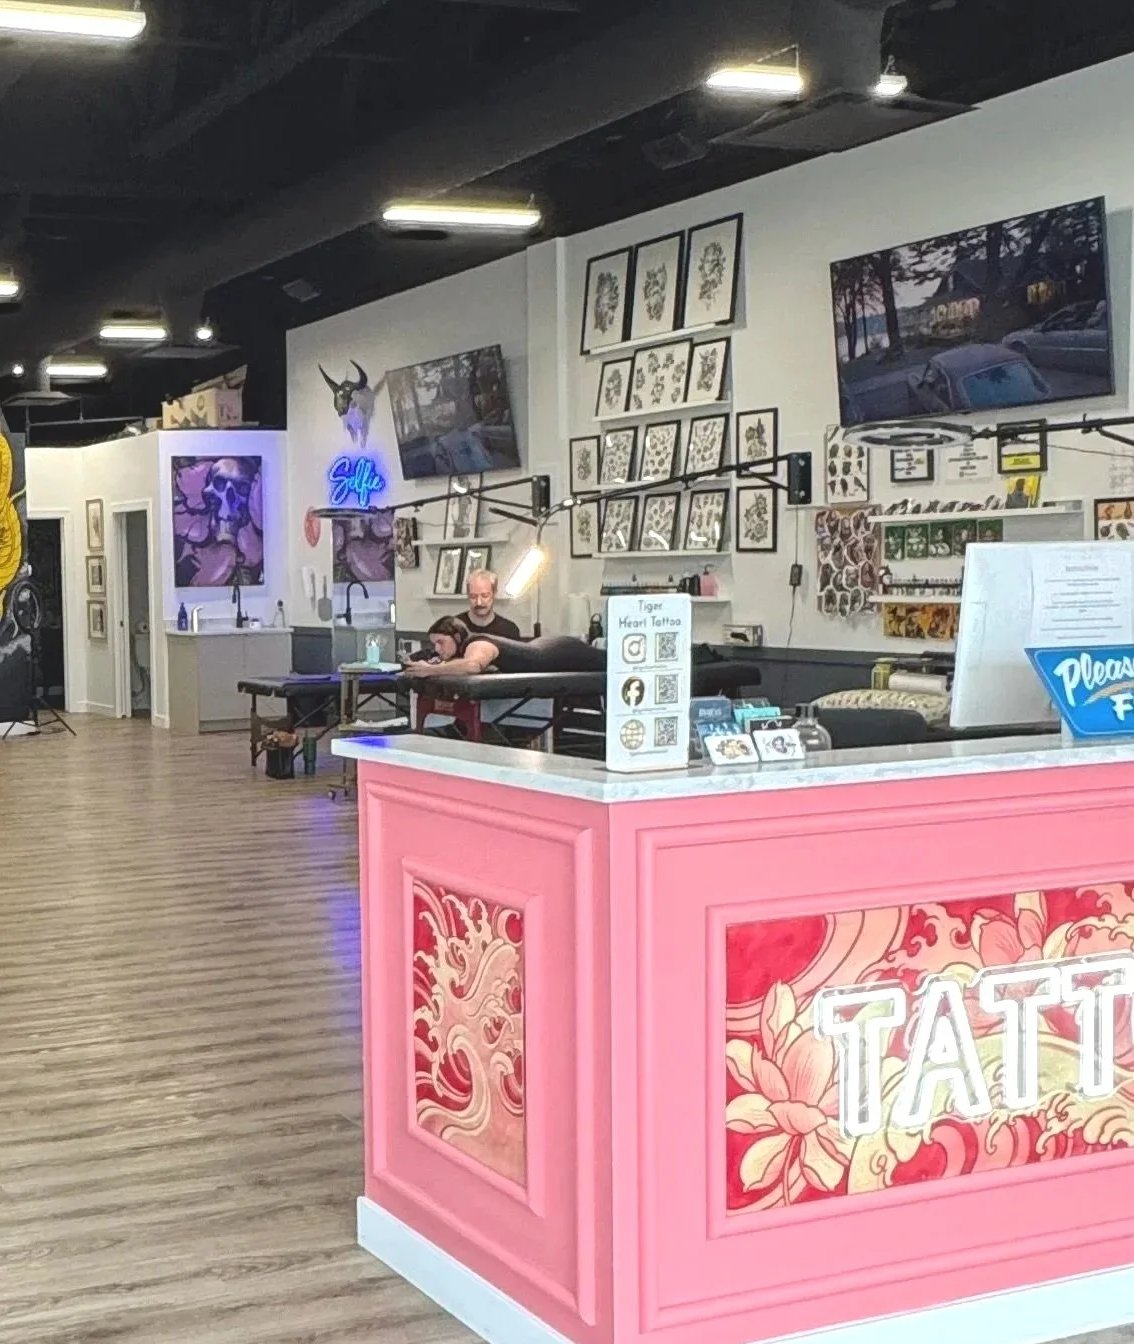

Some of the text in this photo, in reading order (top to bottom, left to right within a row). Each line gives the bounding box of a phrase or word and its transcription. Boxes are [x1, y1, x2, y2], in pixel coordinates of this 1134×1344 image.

[329, 457, 384, 506] Selfie
[638, 600, 663, 613] Tiger
[651, 616, 682, 627] Tattoo
[1053, 652, 1134, 707] Pleas
[1110, 692, 1134, 721] F
[816, 950, 1134, 1138] TATT
